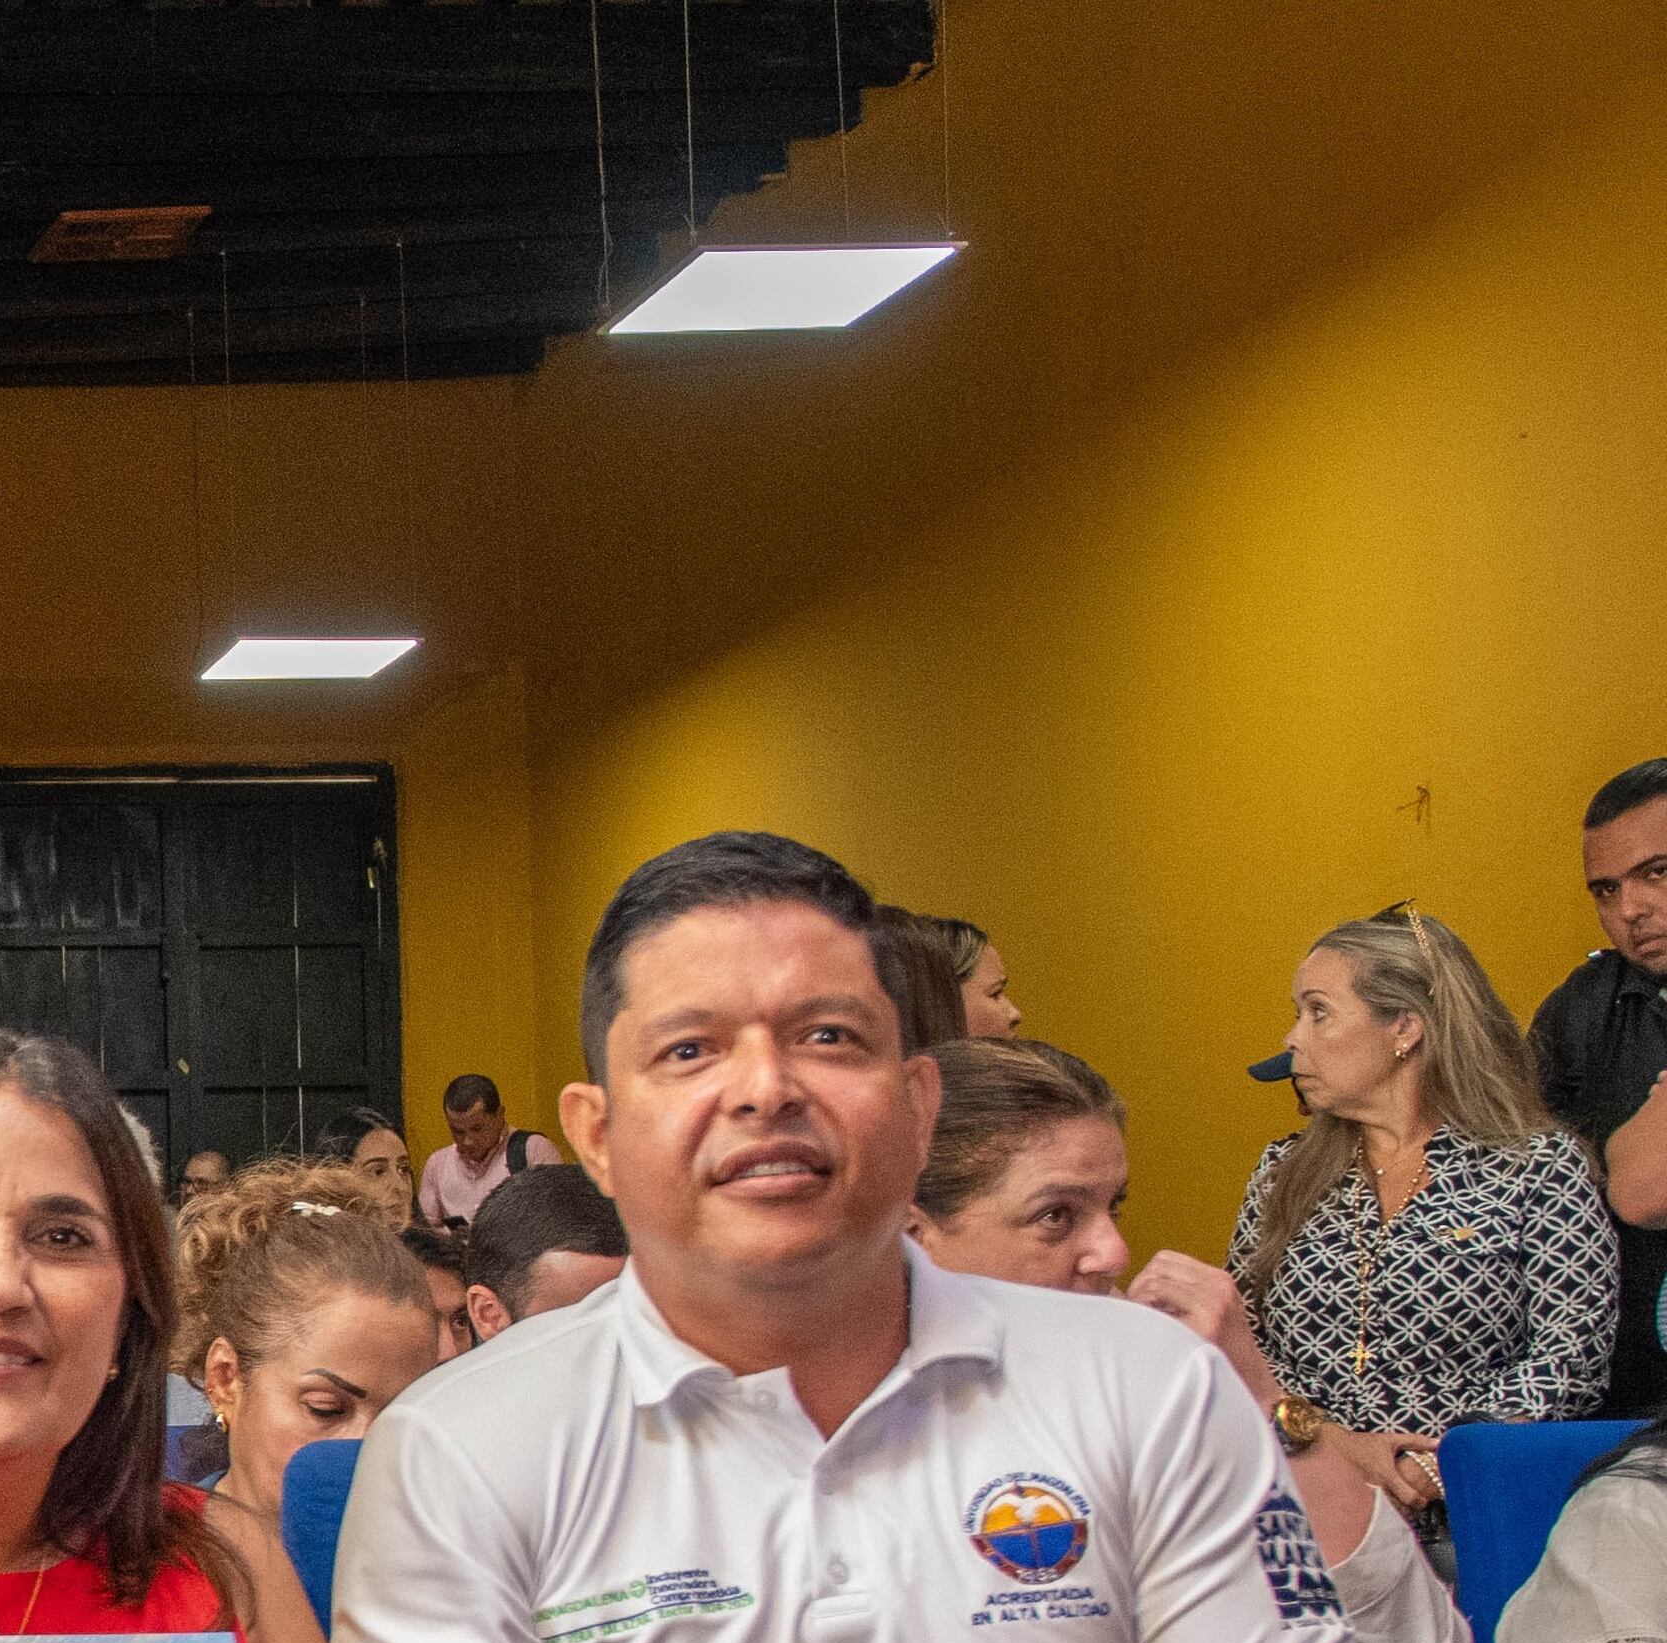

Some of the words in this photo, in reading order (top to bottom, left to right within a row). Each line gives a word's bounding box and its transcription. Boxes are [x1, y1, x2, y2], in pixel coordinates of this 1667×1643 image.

[1030, 1472, 1091, 1516] MAGDALENA
[645, 1567, 709, 1585] Incluyente
[650, 1585, 741, 1605] Comprometida
[985, 1586, 1094, 1606] ACREDITADA
[971, 1610, 993, 1626] EN
[1001, 1606, 1040, 1622] ALTA
[1047, 1602, 1111, 1619] CALIDAD
